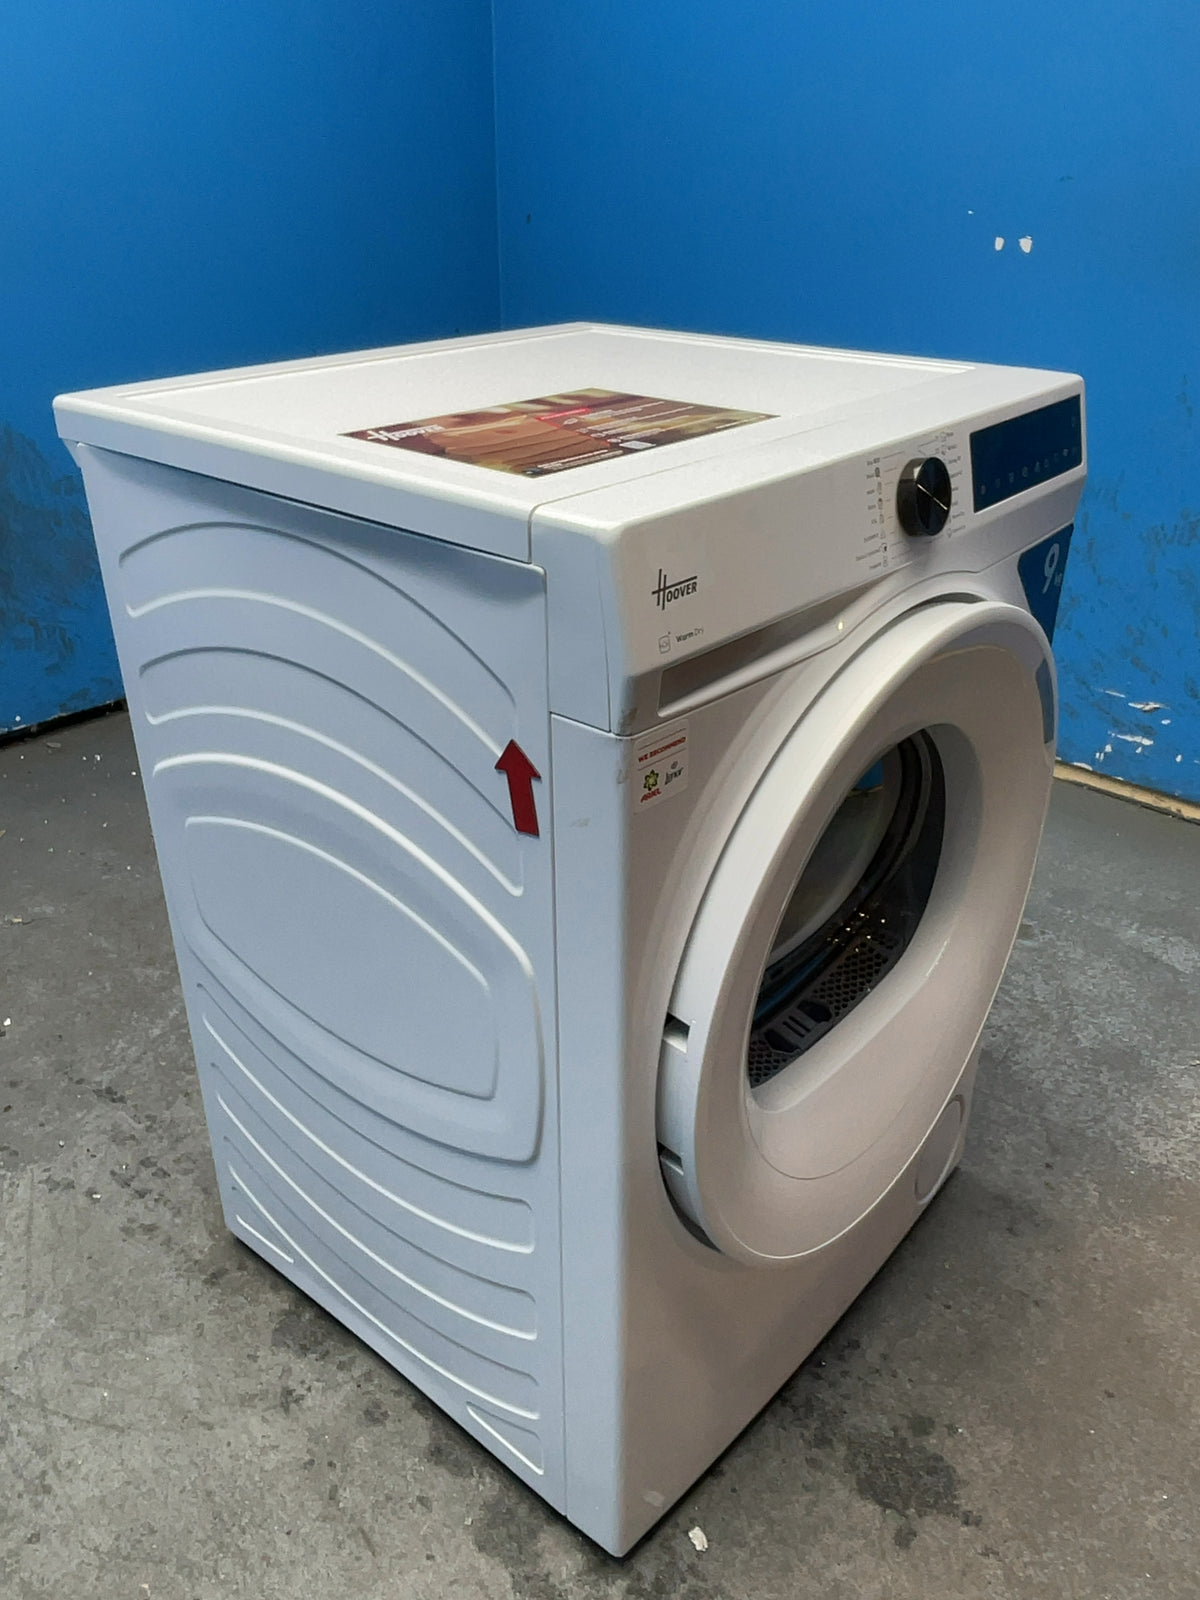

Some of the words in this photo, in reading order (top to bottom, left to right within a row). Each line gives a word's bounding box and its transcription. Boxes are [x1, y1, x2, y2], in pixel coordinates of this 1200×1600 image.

[651, 568, 698, 611] HOOVER
[1042, 543, 1060, 594] 9
[675, 632, 694, 643] Warm
